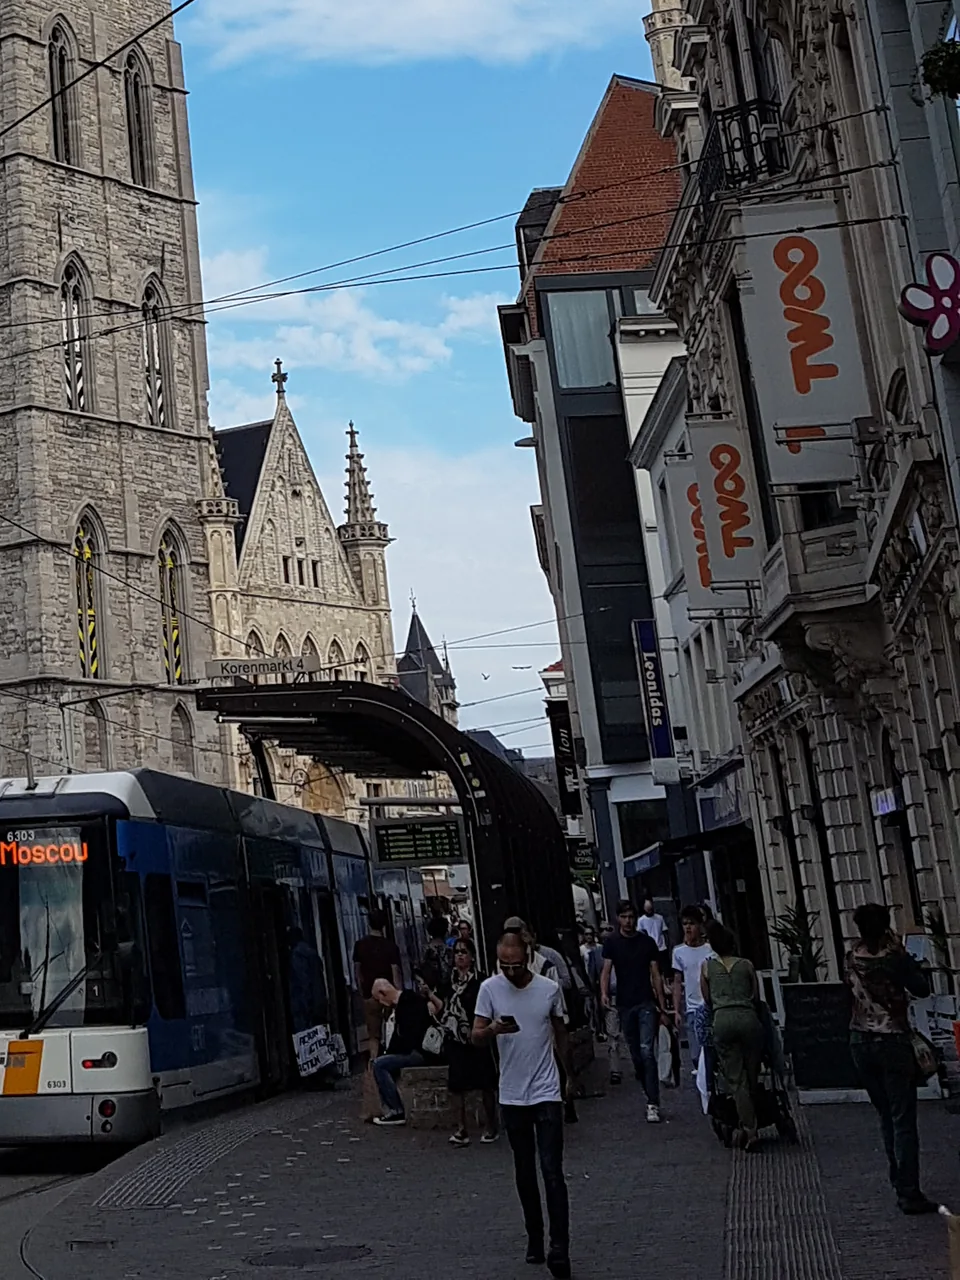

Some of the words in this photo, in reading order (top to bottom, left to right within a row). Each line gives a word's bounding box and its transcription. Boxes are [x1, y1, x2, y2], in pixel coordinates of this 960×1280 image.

[221, 660, 293, 674] Korenmarkt
[297, 659, 304, 669] 4
[642, 651, 663, 727] Leonidas
[6, 831, 35, 842] 6303
[0, 841, 88, 866] Moscou
[47, 1080, 67, 1088] 6303
